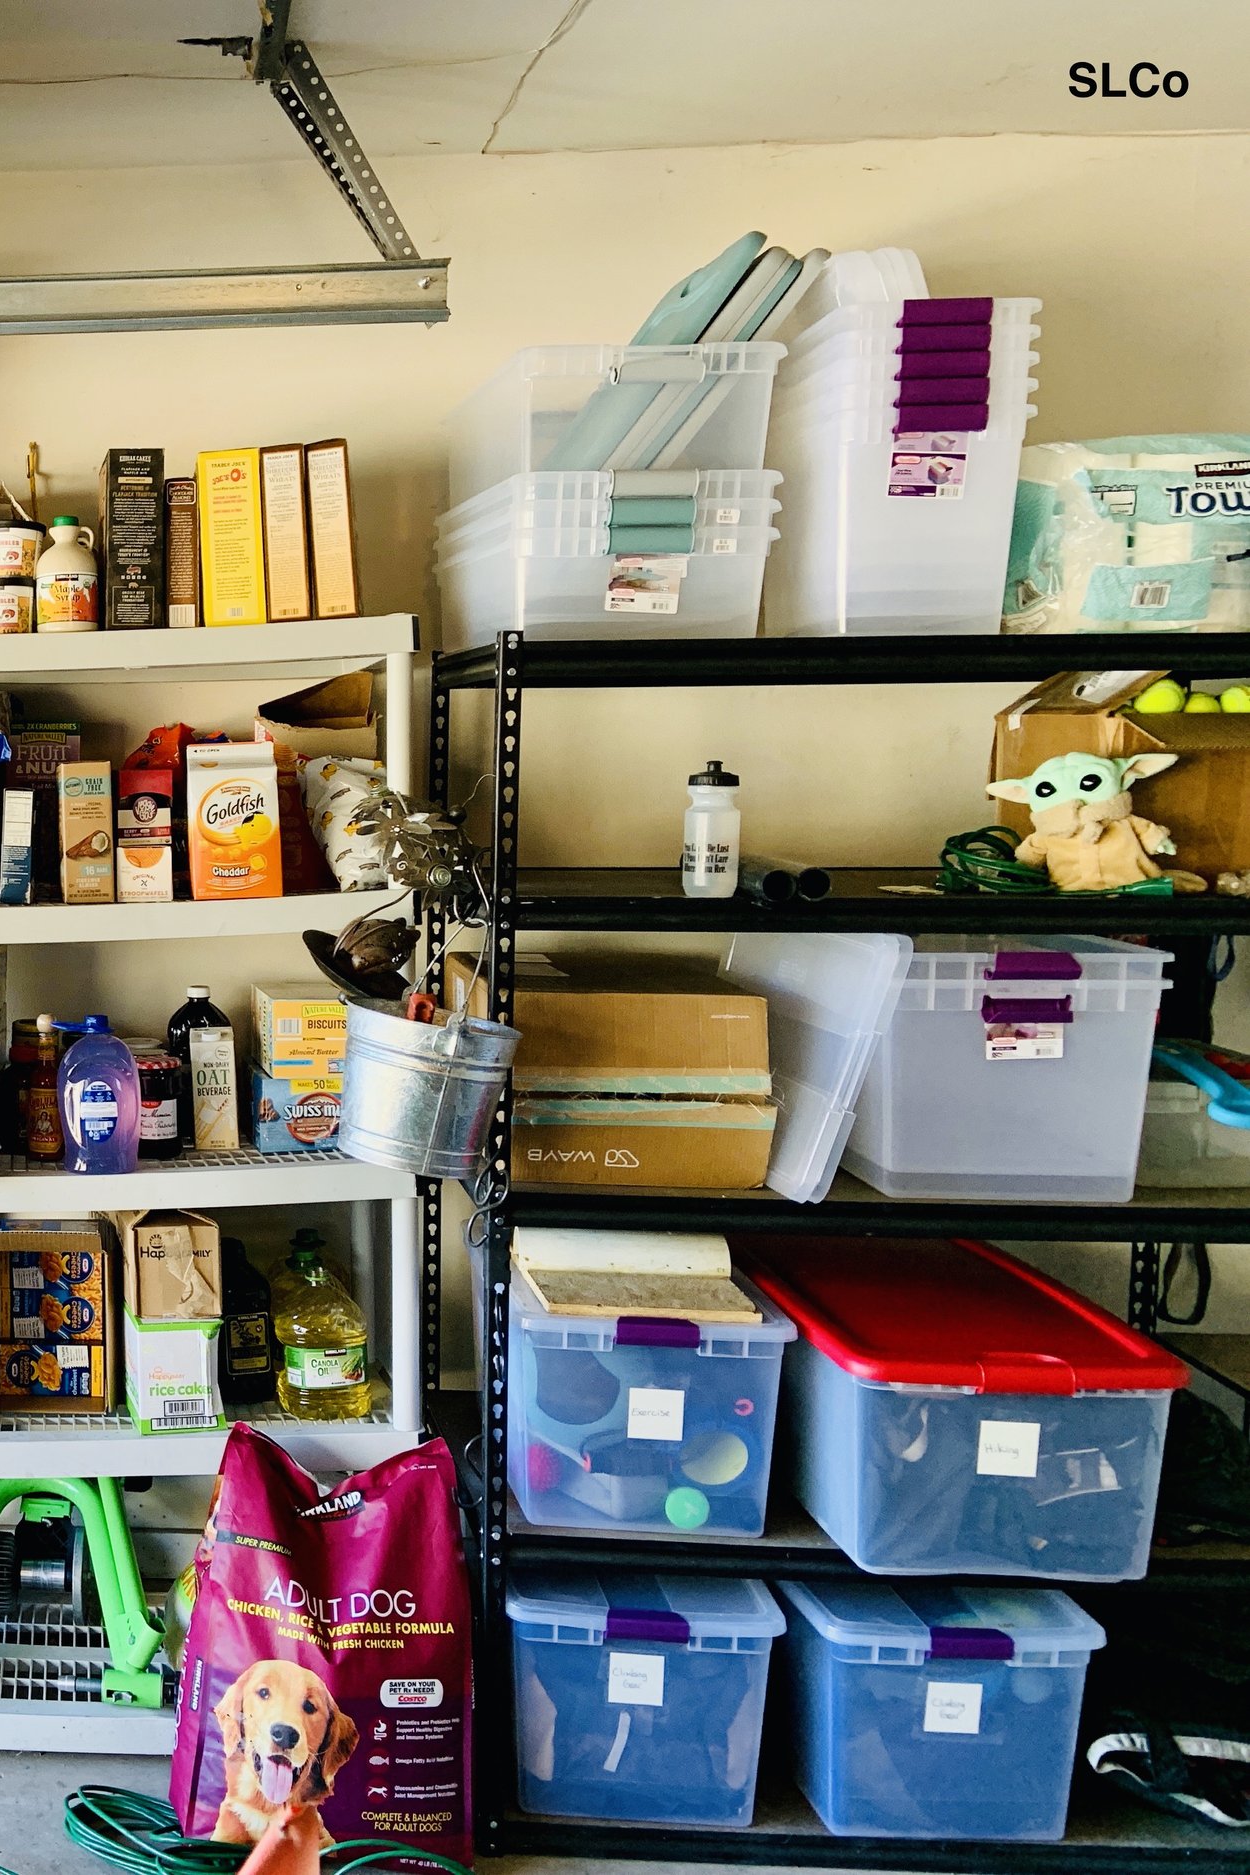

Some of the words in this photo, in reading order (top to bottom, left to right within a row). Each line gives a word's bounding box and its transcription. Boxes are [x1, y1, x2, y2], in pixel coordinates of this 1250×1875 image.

[54, 585, 79, 594] Maple
[55, 594, 80, 603] Syrup
[16, 765, 23, 774] &
[207, 793, 264, 824] Goldfish
[717, 844, 729, 853] Lost
[85, 866, 94, 875] 16
[212, 866, 250, 877] Cheddar
[308, 1020, 347, 1029] BISCUITS
[197, 1070, 230, 1086] OAT
[314, 1080, 325, 1090] 50
[198, 1086, 231, 1096] BEVERAGE
[284, 1105, 321, 1120] SWISS
[528, 1149, 596, 1162] WAYB
[312, 1359, 338, 1367] CANOLA
[318, 1368, 329, 1376] OIL
[149, 1382, 174, 1396] rice
[632, 1408, 670, 1417] Exercise
[984, 1443, 1019, 1459] Hiking
[235, 1536, 258, 1548] SUPER
[260, 1540, 292, 1556] PREMIUM
[264, 1576, 342, 1623] ADULT
[350, 1590, 416, 1618] DOG
[227, 1598, 284, 1623] CHICKEN,
[288, 1612, 314, 1629] RICE
[327, 1622, 391, 1638] VEGETABLE
[395, 1622, 454, 1634] FORMULA
[278, 1627, 304, 1641] MADE
[308, 1634, 330, 1649] WITH
[333, 1640, 362, 1650] FRESH
[365, 1640, 404, 1649] CHICKEN
[192, 1660, 203, 1710] KIRKLAND
[362, 1812, 402, 1822] COMPLETE
[404, 1813, 410, 1822] &
[412, 1812, 452, 1822] BALANCED
[374, 1822, 390, 1831] FOR
[392, 1822, 417, 1832] ADULT
[420, 1822, 442, 1832] DOGS
